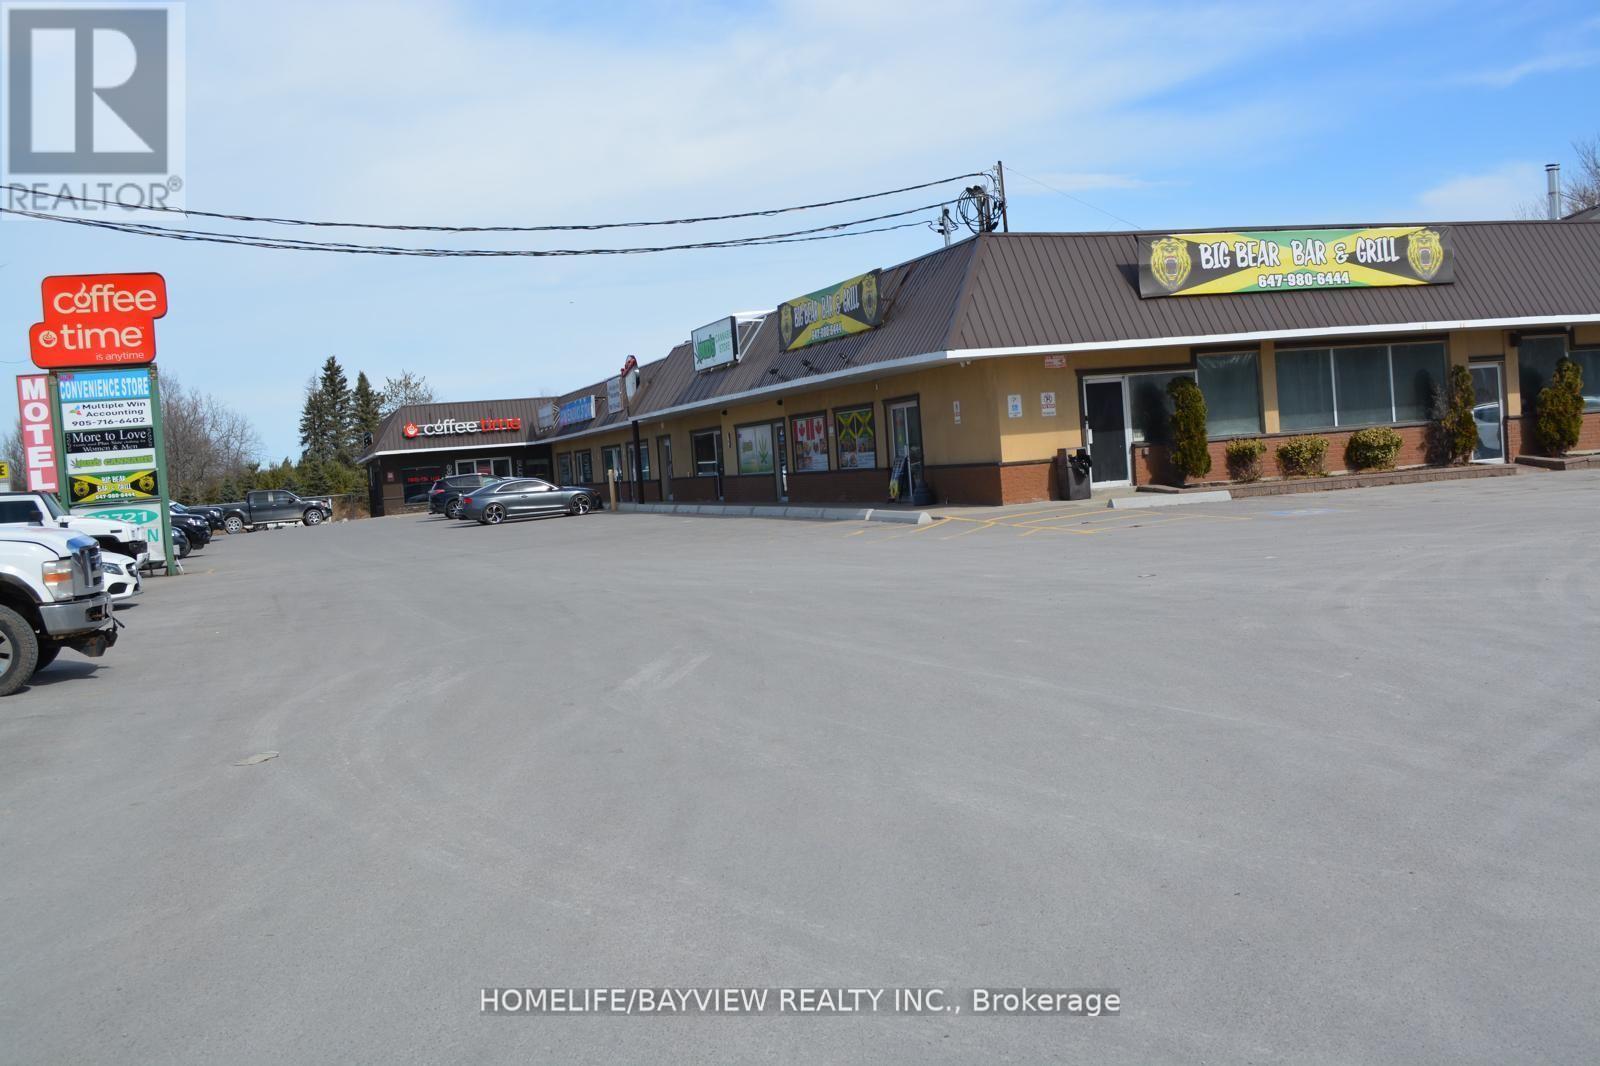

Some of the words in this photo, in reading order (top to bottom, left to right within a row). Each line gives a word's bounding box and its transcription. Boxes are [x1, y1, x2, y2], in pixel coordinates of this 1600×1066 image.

[1199, 240, 1231, 269] BIG
[1234, 239, 1280, 268] BEAR
[1290, 238, 1327, 265] BAR
[1334, 242, 1349, 264] &
[1356, 236, 1400, 264] GRILL
[1257, 271, 1350, 288] 647-980-6444
[53, 282, 157, 314] coffee
[60, 323, 143, 350] time
[96, 352, 103, 361] is
[106, 351, 144, 362] anytime
[60, 377, 120, 399] CONVENIENCE
[121, 376, 149, 396] STORE
[86, 409, 144, 417] Accounting
[72, 417, 146, 427] 905-716-6402
[424, 418, 478, 435] coffee
[480, 416, 521, 433] time
[21, 378, 56, 490] MOTEL
[72, 433, 101, 443] More
[105, 432, 116, 441] to
[120, 429, 146, 440] Love
